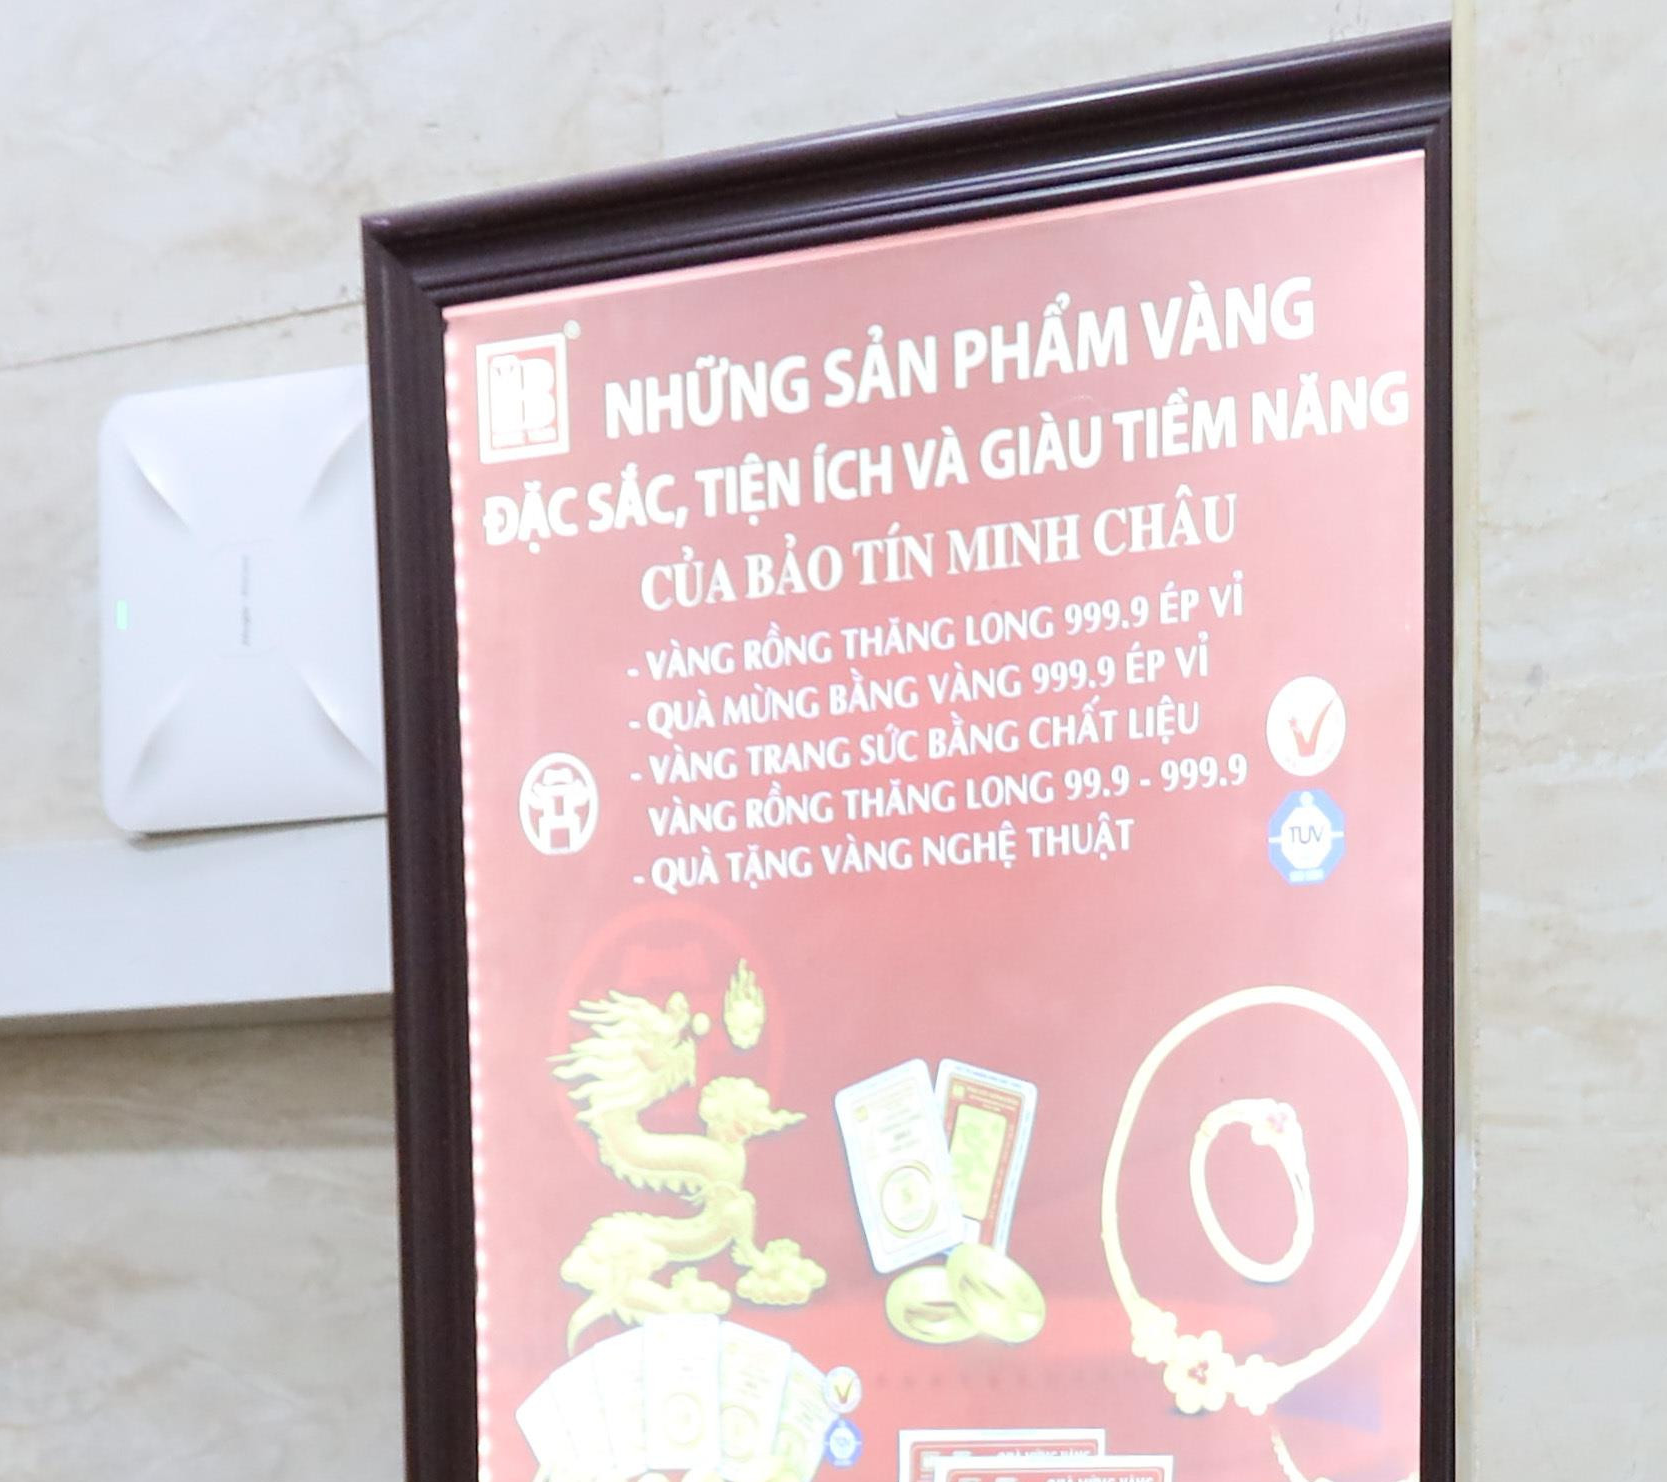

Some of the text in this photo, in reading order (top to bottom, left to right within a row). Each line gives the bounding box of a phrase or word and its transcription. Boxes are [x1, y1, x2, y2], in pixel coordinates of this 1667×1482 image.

[605, 276, 1315, 440] NHỮNG SẢN PHẨM VÀNG
[482, 369, 1411, 555] ĐẶC SẮC, TIỆN ÍCH VÀ GIÀU TIỀM NĂNG
[641, 483, 1238, 612] CỦA BẢO TÍN MINH CHÂU
[645, 569, 1244, 681] VÀNG RỒNG THĂNG LONG 999.9 ÉP VỈ
[646, 630, 1210, 739] QUÀ MỪNG BẰNG VÀNG 999.9 ÉP VỈ
[648, 693, 1200, 785] VÀNG TRANG SỨC BẰNG CHẤT LIỆU
[648, 753, 1248, 838] VÀNG RỒNG THĂNG LONG 99.9 999.9
[651, 811, 1135, 895] QUÀ TẶNG VÀNG NGHỆ THUẬT
